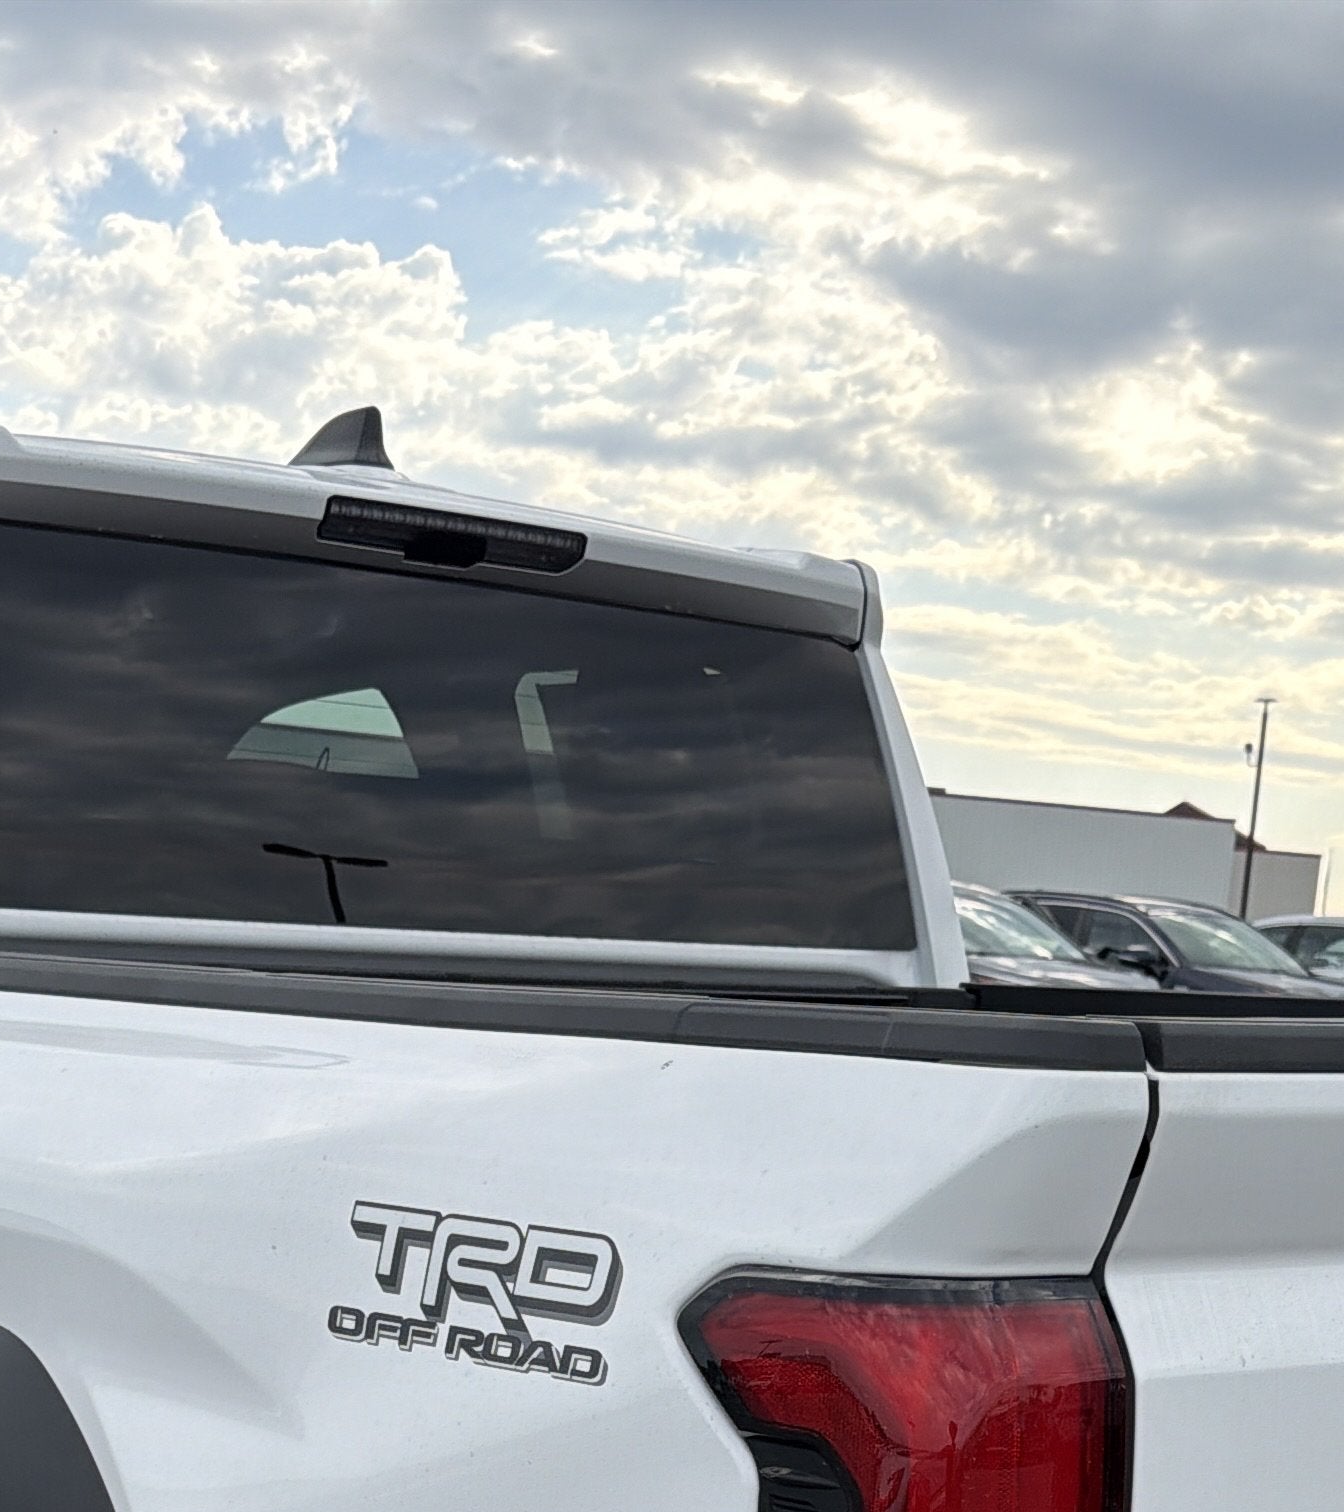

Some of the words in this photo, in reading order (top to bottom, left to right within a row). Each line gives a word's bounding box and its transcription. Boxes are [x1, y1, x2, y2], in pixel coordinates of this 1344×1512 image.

[350, 1199, 624, 1334] TRD
[327, 1305, 440, 1352] OFF
[444, 1325, 609, 1387] ROAD
